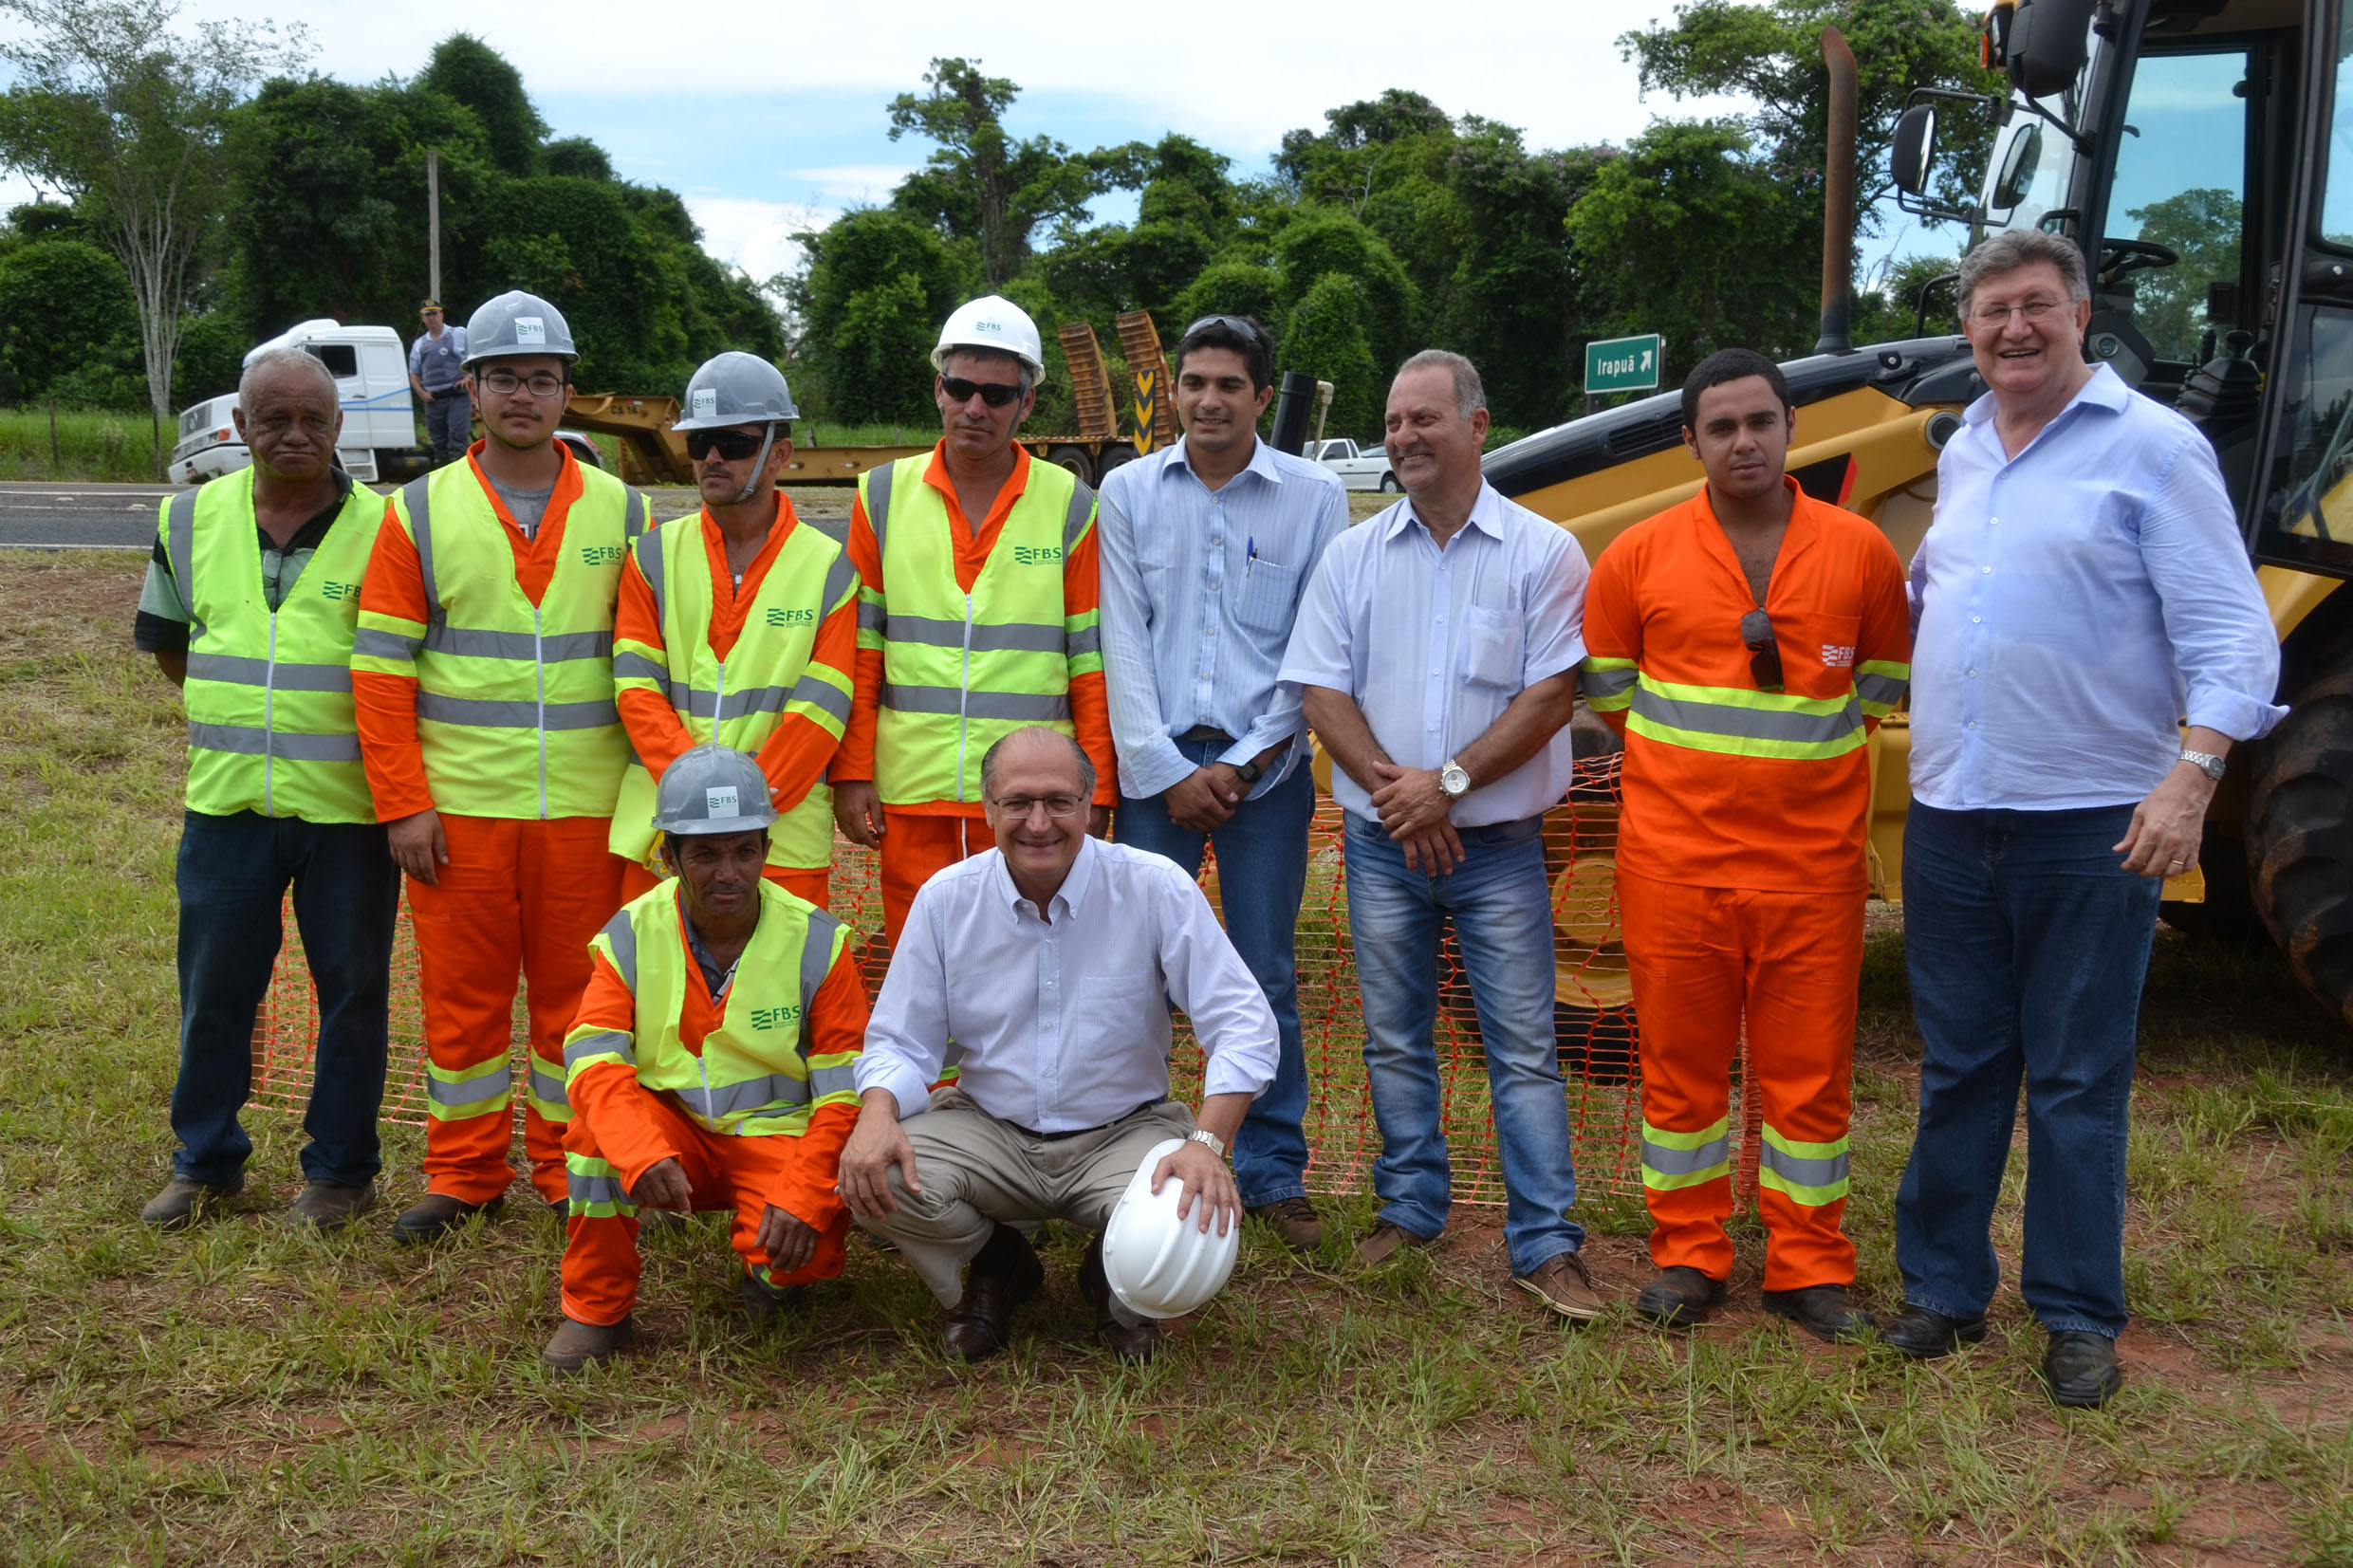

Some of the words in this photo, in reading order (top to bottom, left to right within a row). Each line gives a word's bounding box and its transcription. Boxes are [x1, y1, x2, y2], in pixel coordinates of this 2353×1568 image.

[986, 322, 1002, 331] FBS
[1597, 355, 1635, 378] Irapuã
[701, 397, 714, 405] FBS
[599, 546, 621, 560] FBS
[1032, 546, 1062, 560] FBS
[343, 583, 361, 598] FB
[786, 608, 814, 621] FBS
[1838, 646, 1856, 660] FBS
[720, 796, 737, 804] FBS
[772, 1005, 801, 1022] FBS
